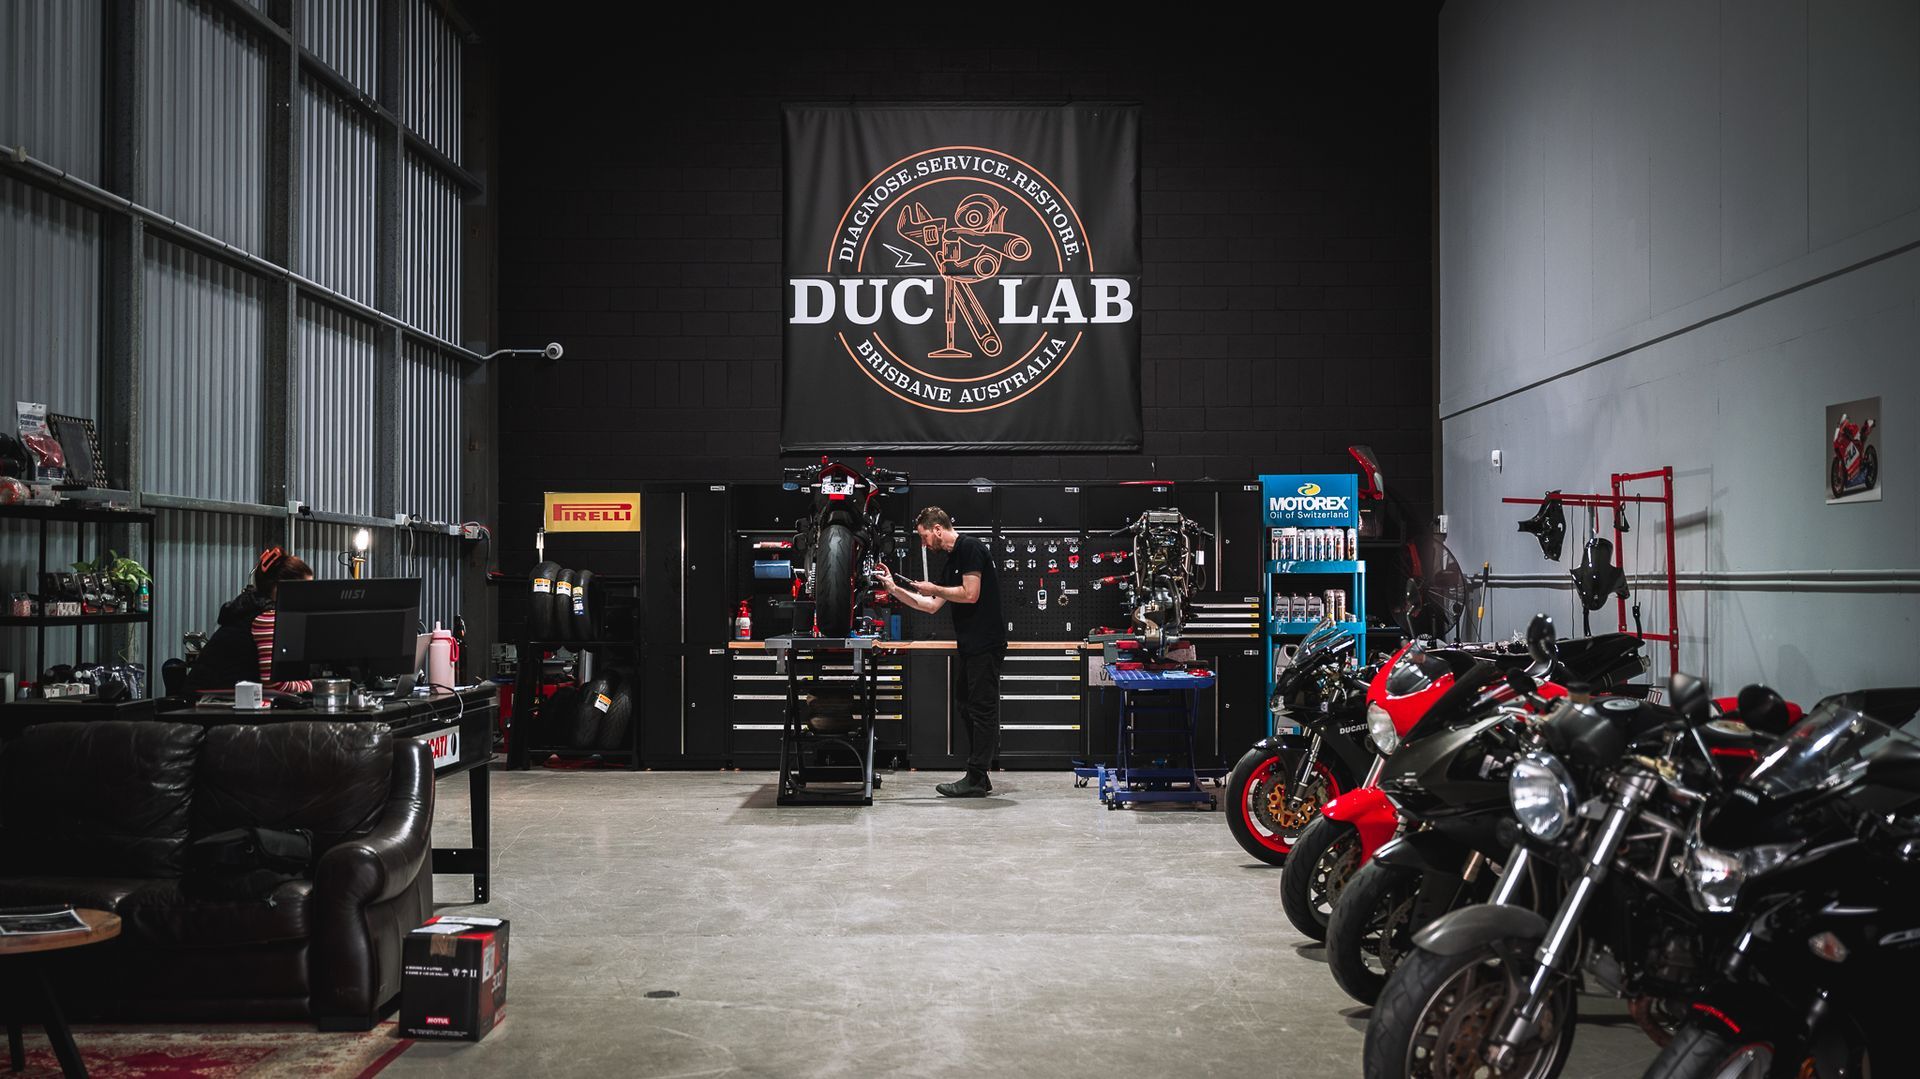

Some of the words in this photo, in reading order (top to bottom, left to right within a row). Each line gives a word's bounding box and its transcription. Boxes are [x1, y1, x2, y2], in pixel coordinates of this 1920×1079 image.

[789, 279, 933, 324] DUC
[998, 279, 1133, 324] LAB
[857, 339, 952, 402] BRISBANE
[959, 337, 1067, 402] AUSTRALIA
[1270, 497, 1348, 511] MOTOREX
[553, 504, 632, 521] PIRELLI
[1270, 511, 1282, 519] Oil
[1285, 511, 1294, 519] of
[1297, 511, 1349, 519] Switzerland
[1339, 723, 1368, 735] DUCATI
